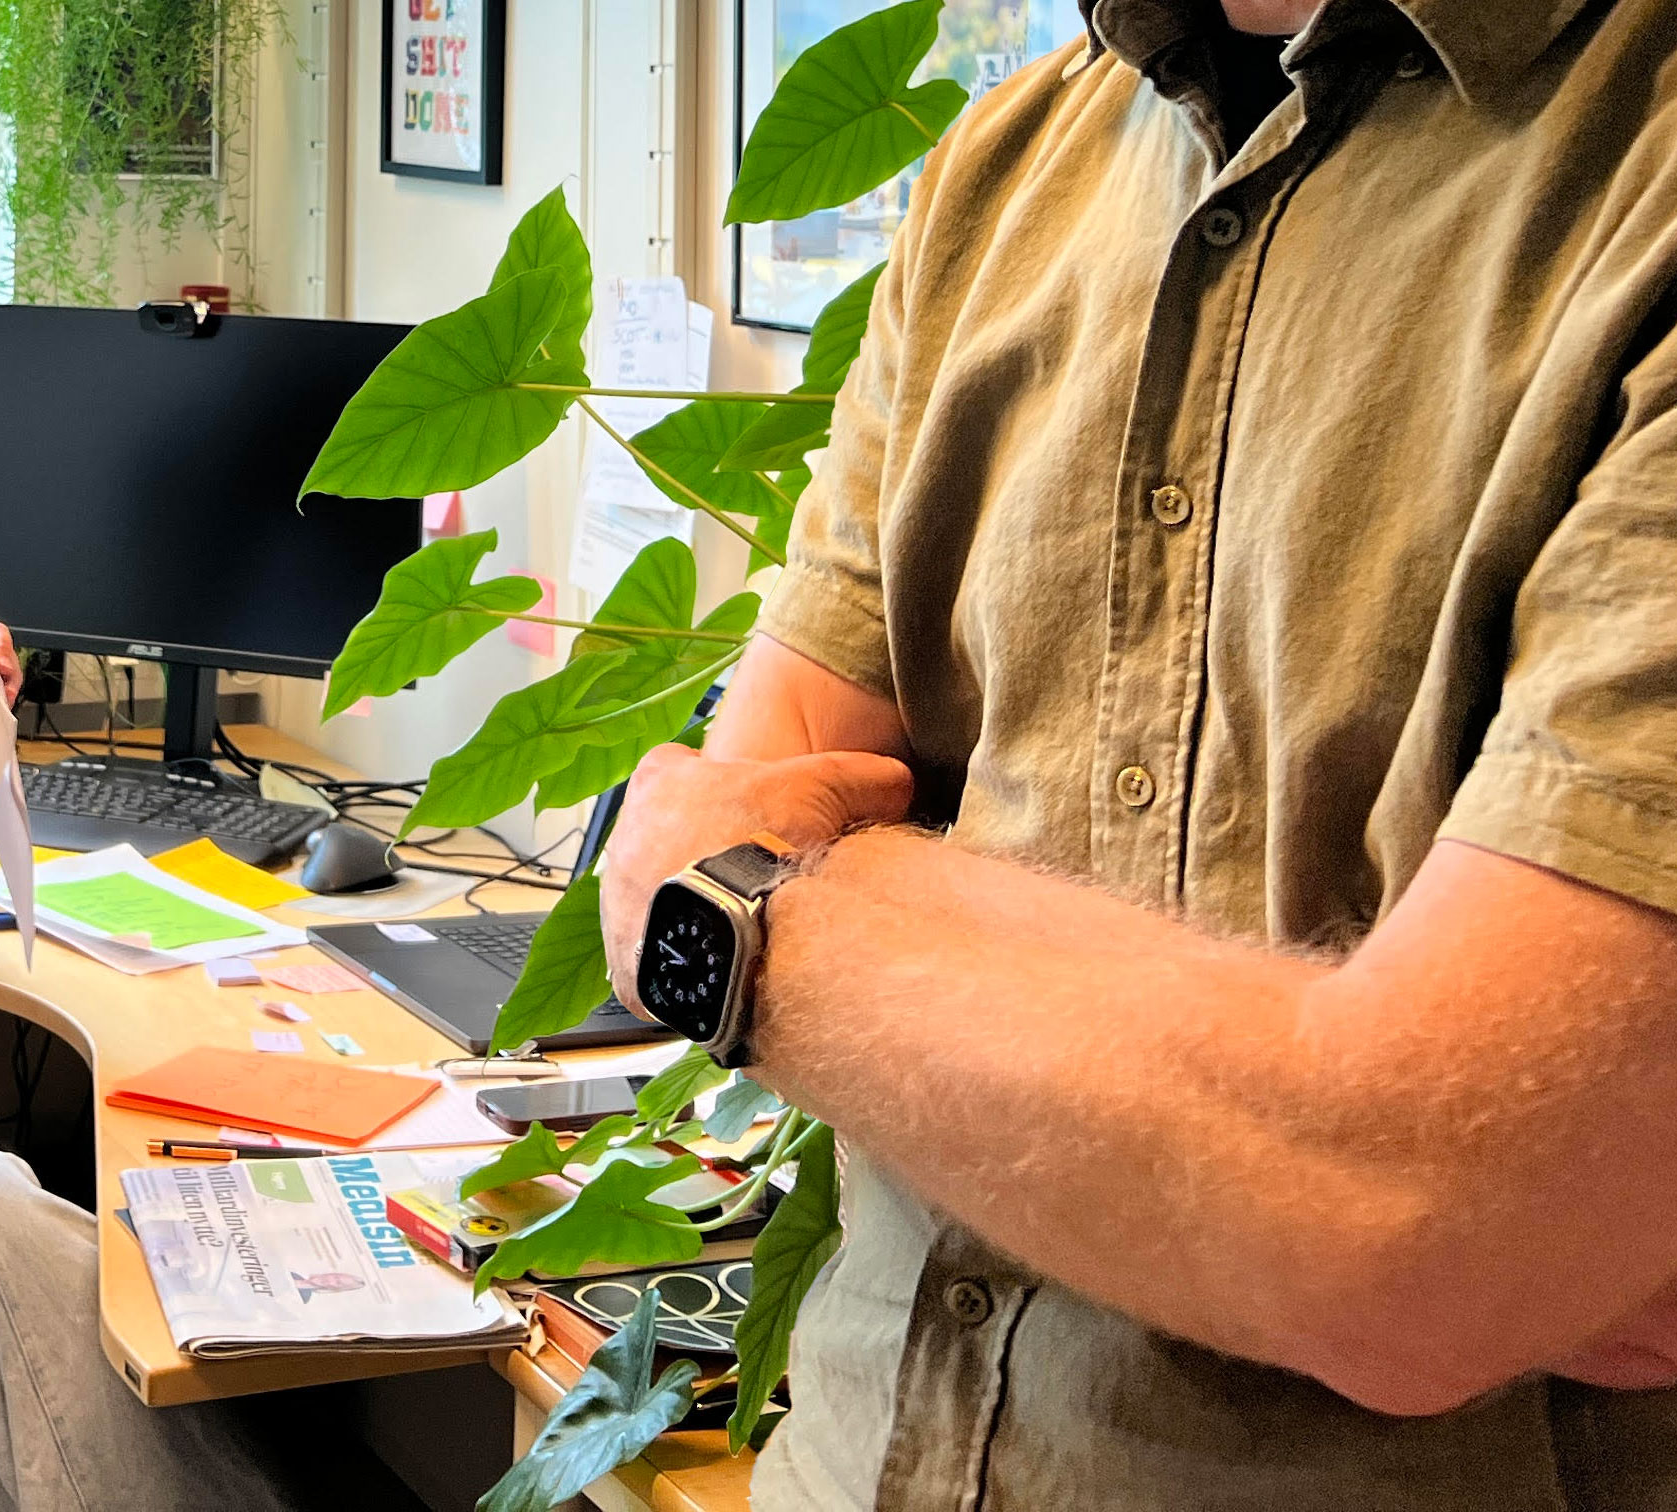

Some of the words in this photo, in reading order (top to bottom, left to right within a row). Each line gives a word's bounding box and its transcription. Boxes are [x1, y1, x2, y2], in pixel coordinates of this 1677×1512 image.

[406, 36, 467, 78] SHIT
[404, 89, 470, 135] DONE
[176, 1181, 204, 1209] liten
[326, 1157, 416, 1268] Medisin
